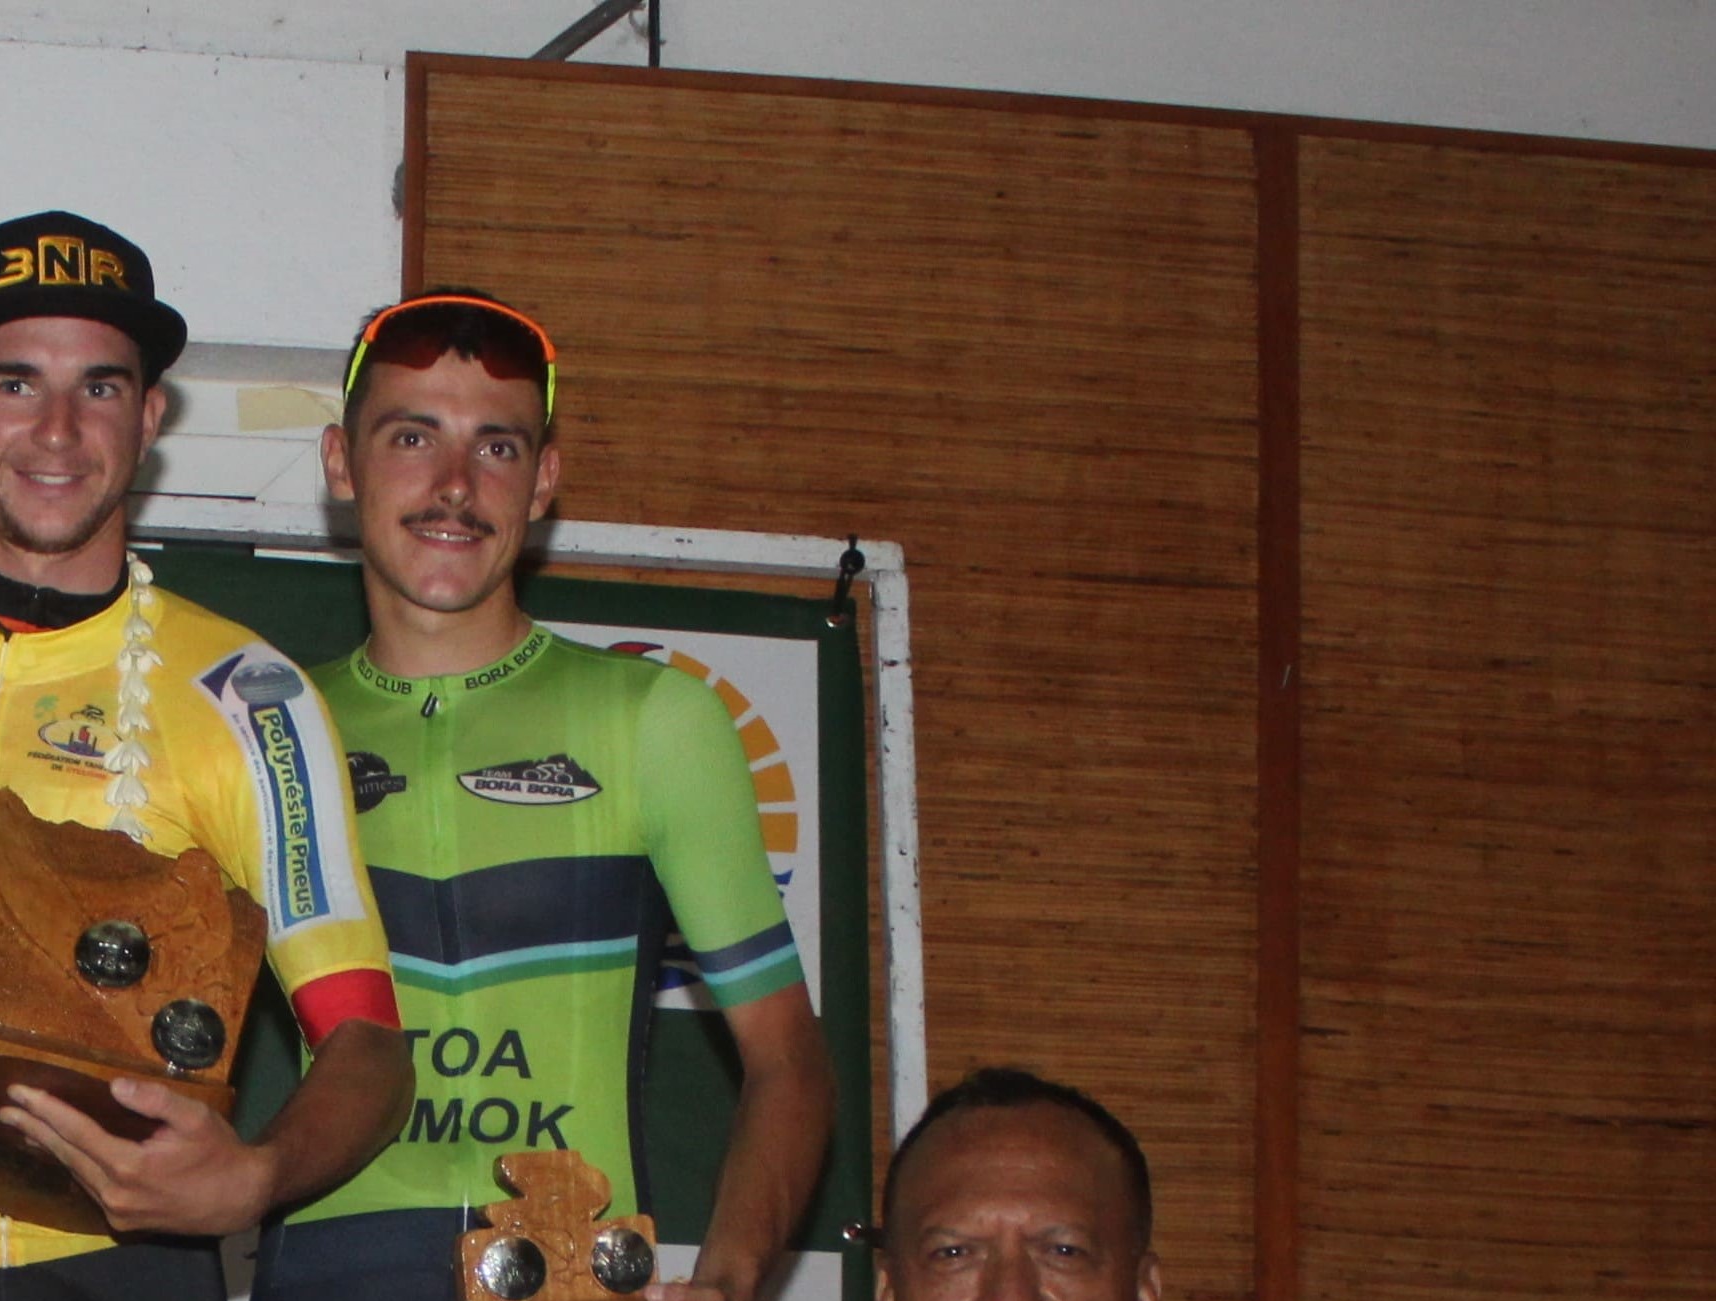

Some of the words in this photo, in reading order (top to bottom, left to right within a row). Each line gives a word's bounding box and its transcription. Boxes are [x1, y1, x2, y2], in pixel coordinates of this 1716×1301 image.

[464, 664, 517, 691] BORA
[512, 632, 547, 667] BORA
[375, 675, 413, 695] CLUB
[474, 778, 522, 793] BORA
[526, 783, 576, 799] BORA
[482, 769, 513, 780] TEAM
[262, 712, 306, 836] Polynésie
[291, 844, 313, 916] Pneus
[395, 1097, 575, 1151] MOK
